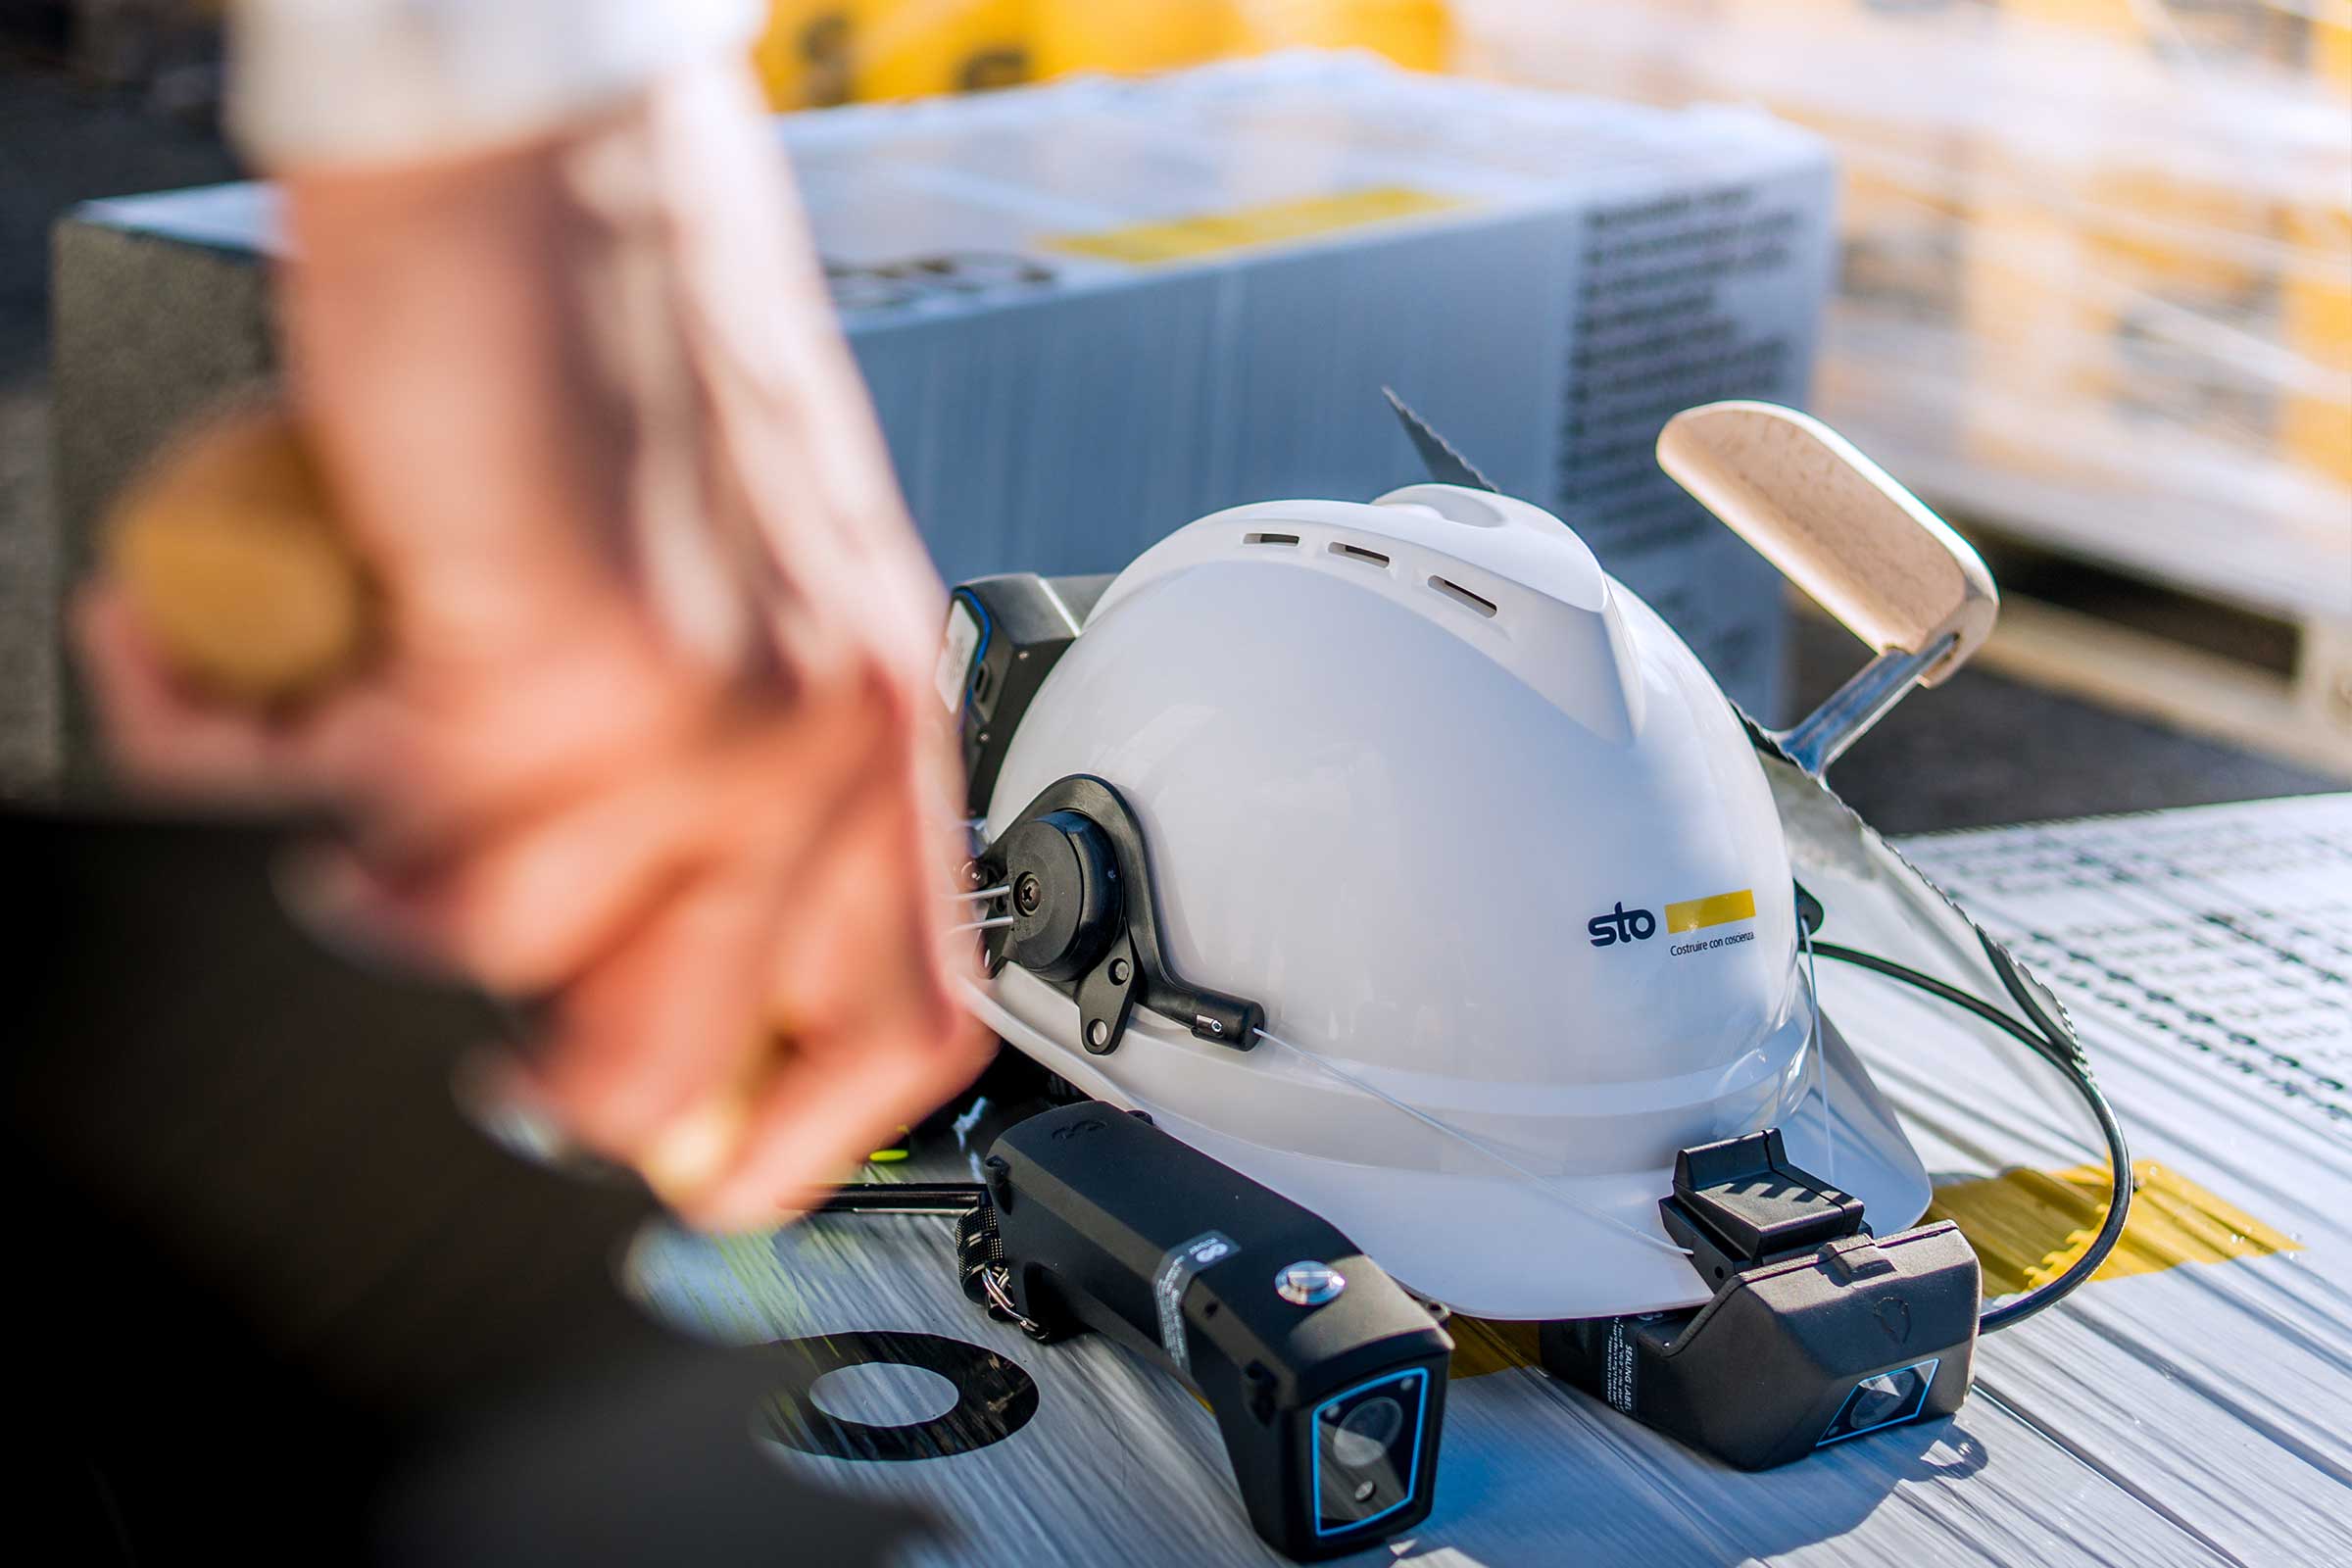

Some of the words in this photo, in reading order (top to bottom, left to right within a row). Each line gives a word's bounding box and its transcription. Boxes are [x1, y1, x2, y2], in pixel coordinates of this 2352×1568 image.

[1588, 902, 1656, 947] sto
[1670, 942, 1708, 956] Costruire
[1709, 938, 1724, 949] con
[1725, 931, 1754, 945] coscienza
[1624, 1344, 1633, 1384] SEALING
